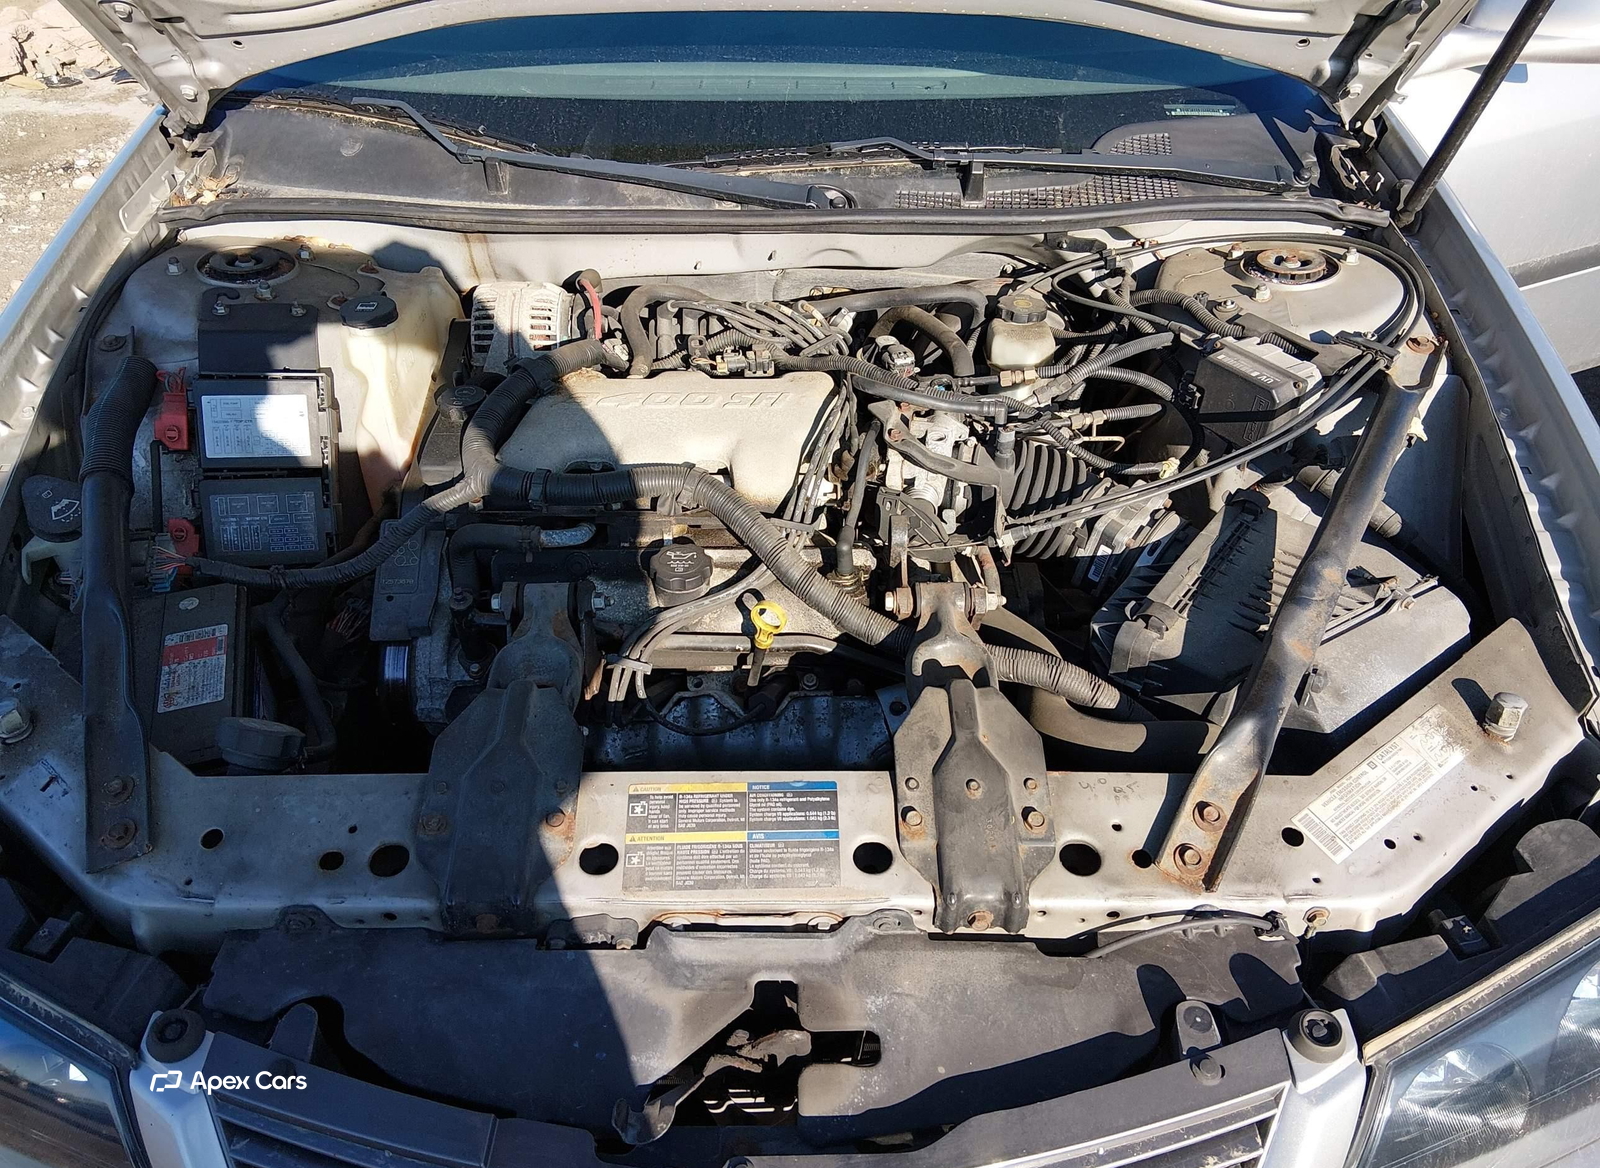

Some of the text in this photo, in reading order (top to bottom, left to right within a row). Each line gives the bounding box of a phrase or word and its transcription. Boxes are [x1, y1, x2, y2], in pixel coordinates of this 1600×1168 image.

[1376, 740, 1399, 761] CATALYST
[1320, 794, 1337, 807] VEHICLE
[1351, 769, 1368, 783] CONTROL
